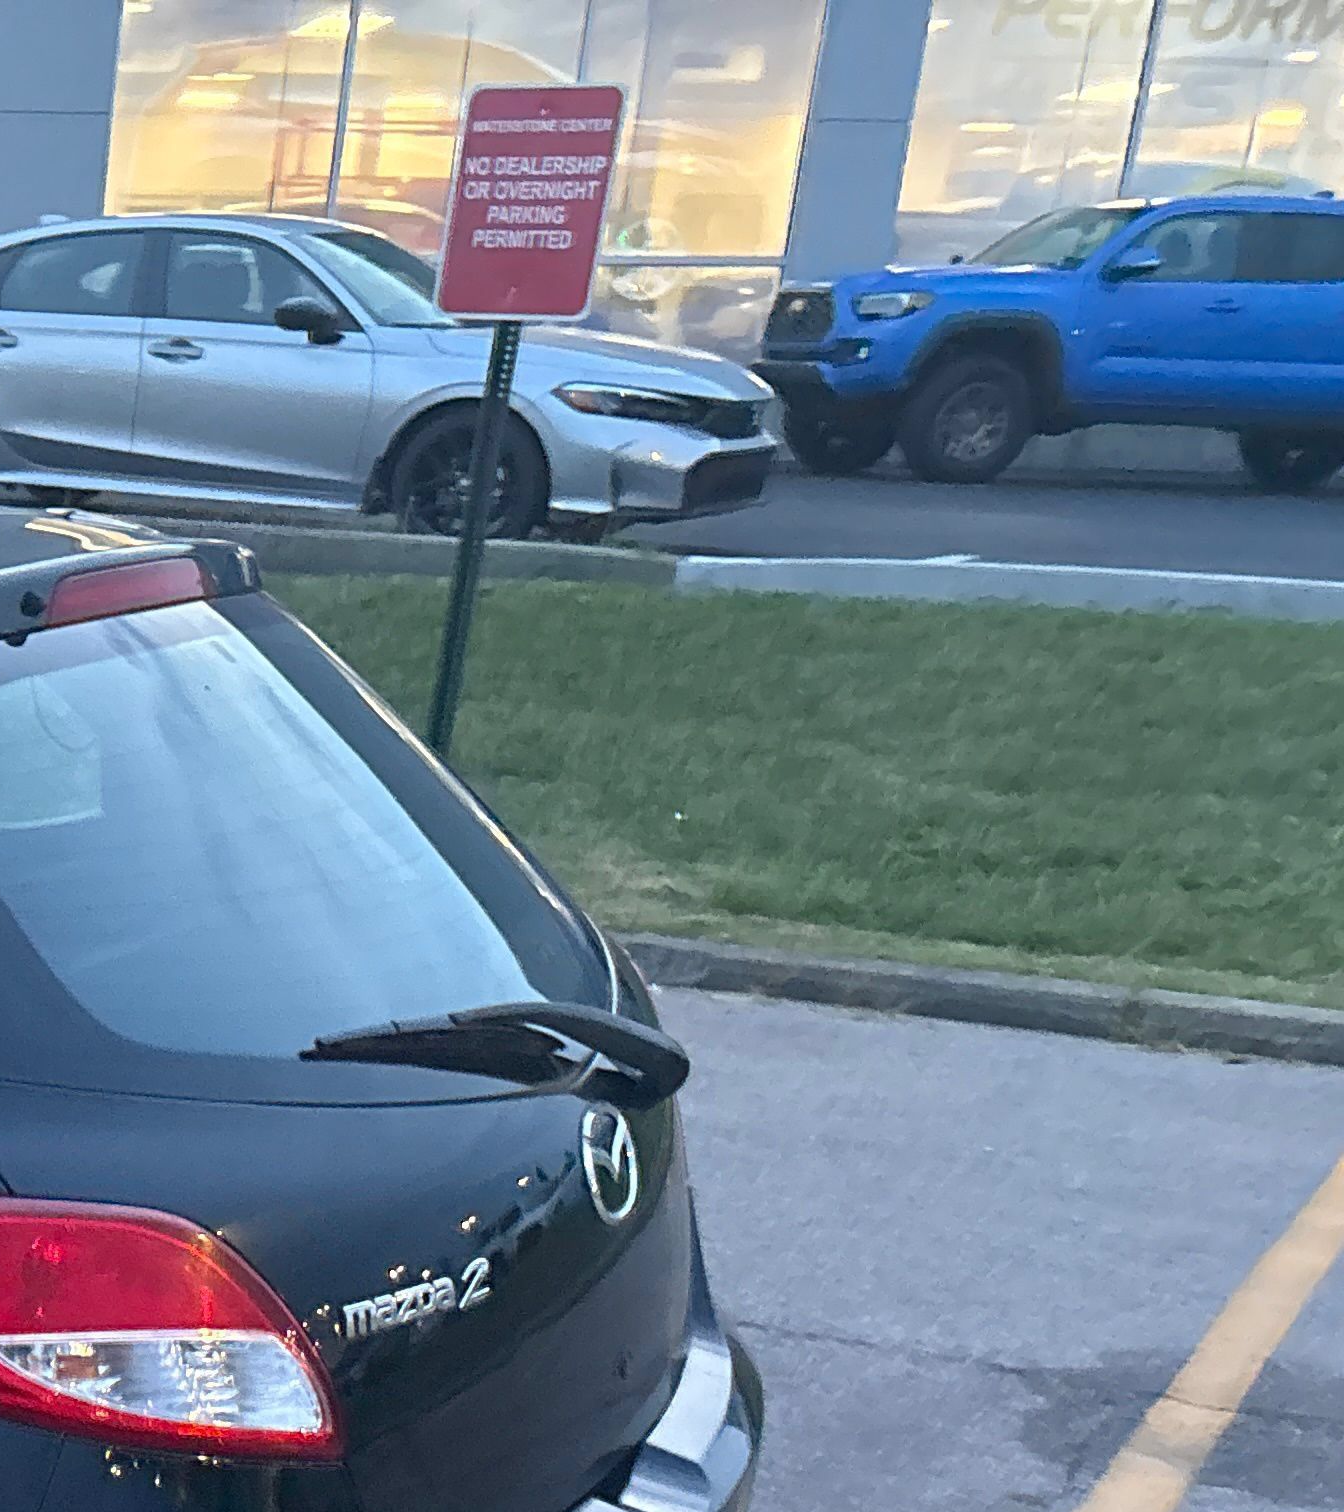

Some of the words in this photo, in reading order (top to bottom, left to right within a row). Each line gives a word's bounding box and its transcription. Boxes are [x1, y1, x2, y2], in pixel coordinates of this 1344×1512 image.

[465, 156, 490, 174] NO
[495, 156, 607, 175] DEALERSHIP
[464, 181, 490, 200] OR
[495, 180, 601, 200] OVERNIGHT
[486, 205, 565, 225] PARKING
[472, 229, 572, 249] PERMITTED
